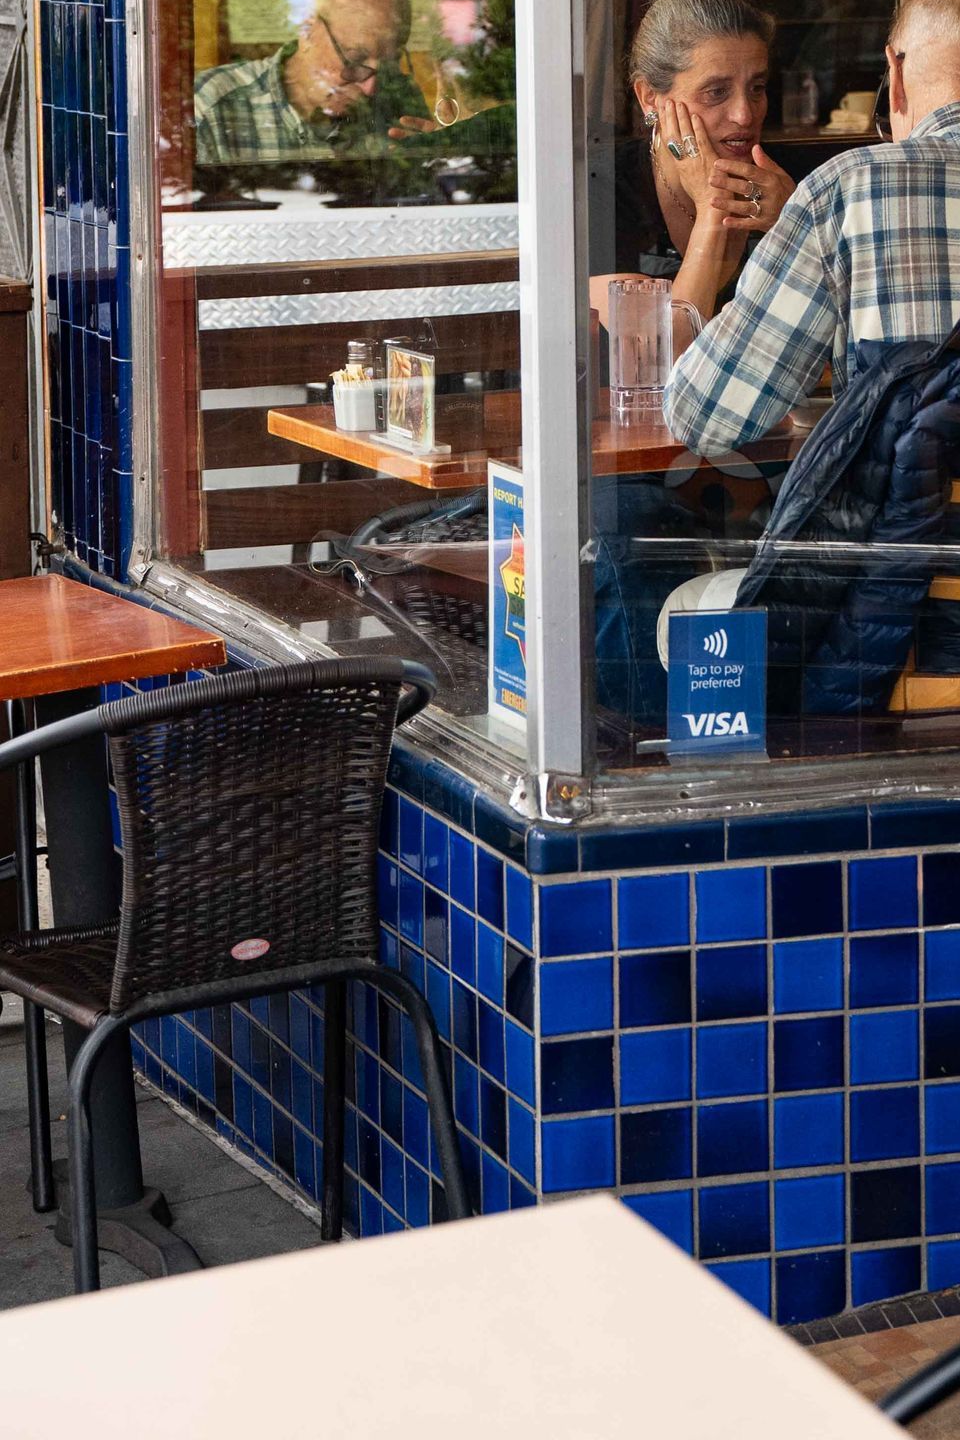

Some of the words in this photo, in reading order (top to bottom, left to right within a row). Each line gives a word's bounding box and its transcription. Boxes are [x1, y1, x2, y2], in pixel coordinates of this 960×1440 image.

[688, 664, 707, 677] Tap
[710, 665, 722, 675] to
[724, 664, 744, 677] pay
[691, 676, 741, 692] preferred
[682, 711, 750, 737] VISA
